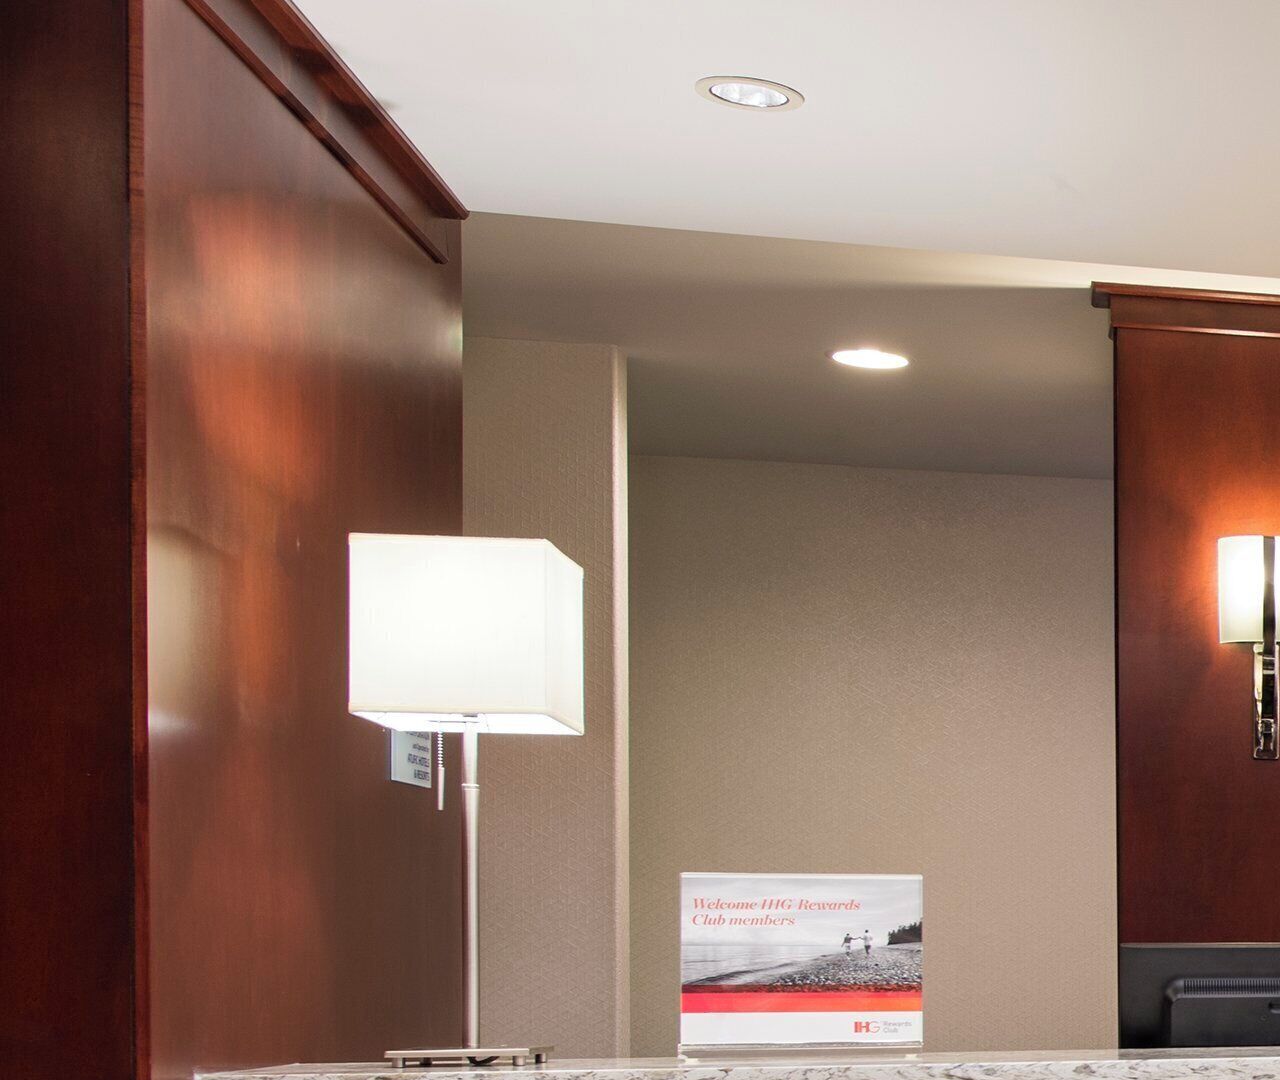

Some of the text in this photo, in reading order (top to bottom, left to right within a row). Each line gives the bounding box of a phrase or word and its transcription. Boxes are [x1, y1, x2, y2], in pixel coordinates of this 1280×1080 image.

[693, 897, 861, 911] Welcome IHG Rewards
[692, 914, 796, 926] Club members
[854, 1020, 881, 1033] IHG
